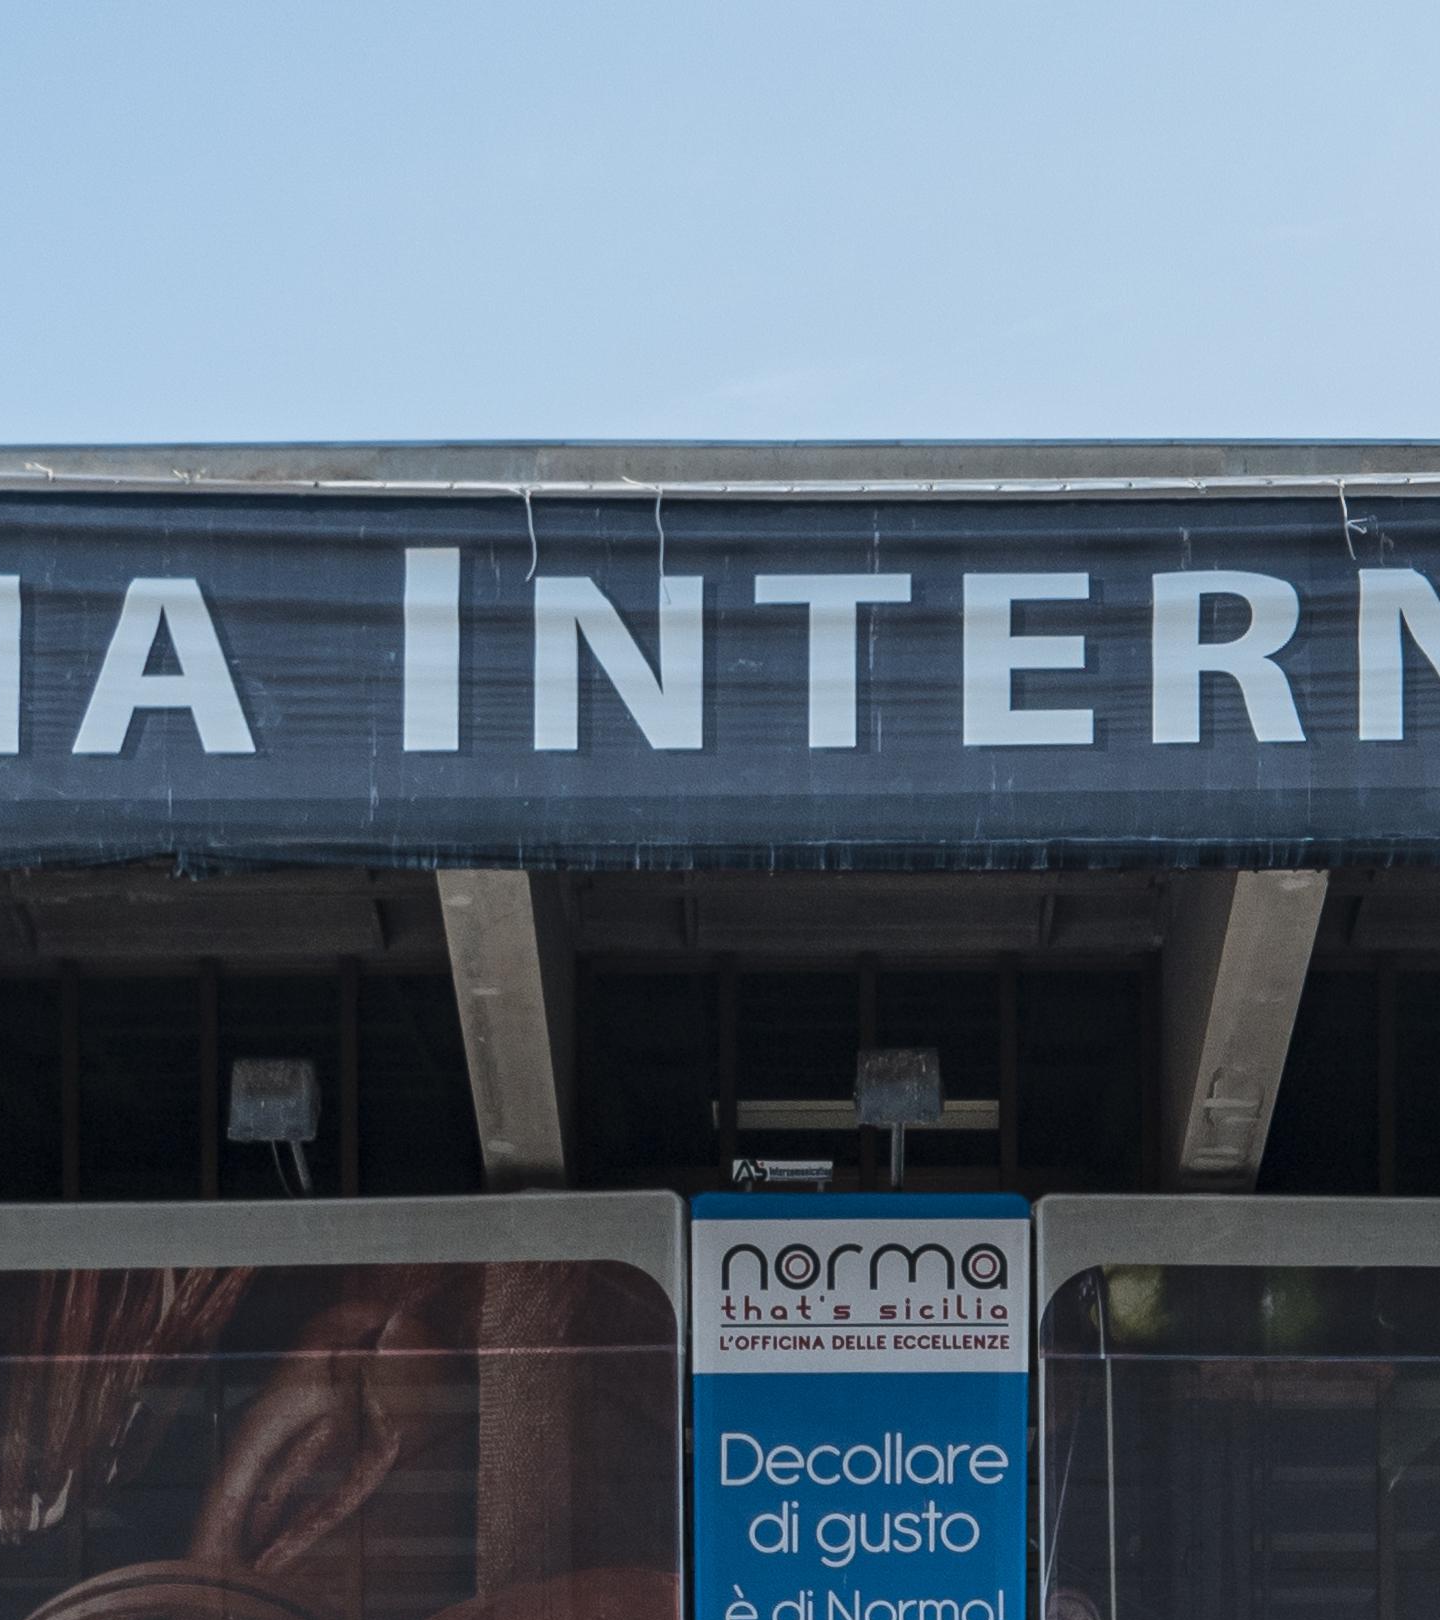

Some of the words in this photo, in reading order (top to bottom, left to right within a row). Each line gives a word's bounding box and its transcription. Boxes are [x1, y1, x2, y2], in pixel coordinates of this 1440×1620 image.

[720, 1242, 1008, 1291] norma
[720, 1295, 851, 1321] that's
[878, 1295, 1008, 1321] sicilia
[719, 1334, 825, 1351] L'OFFICINA
[832, 1334, 887, 1351] DELLE
[893, 1334, 1010, 1351] ECCELLENZE
[720, 1432, 1009, 1486] Decollare
[748, 1500, 799, 1554] di
[815, 1500, 980, 1568] gusto
